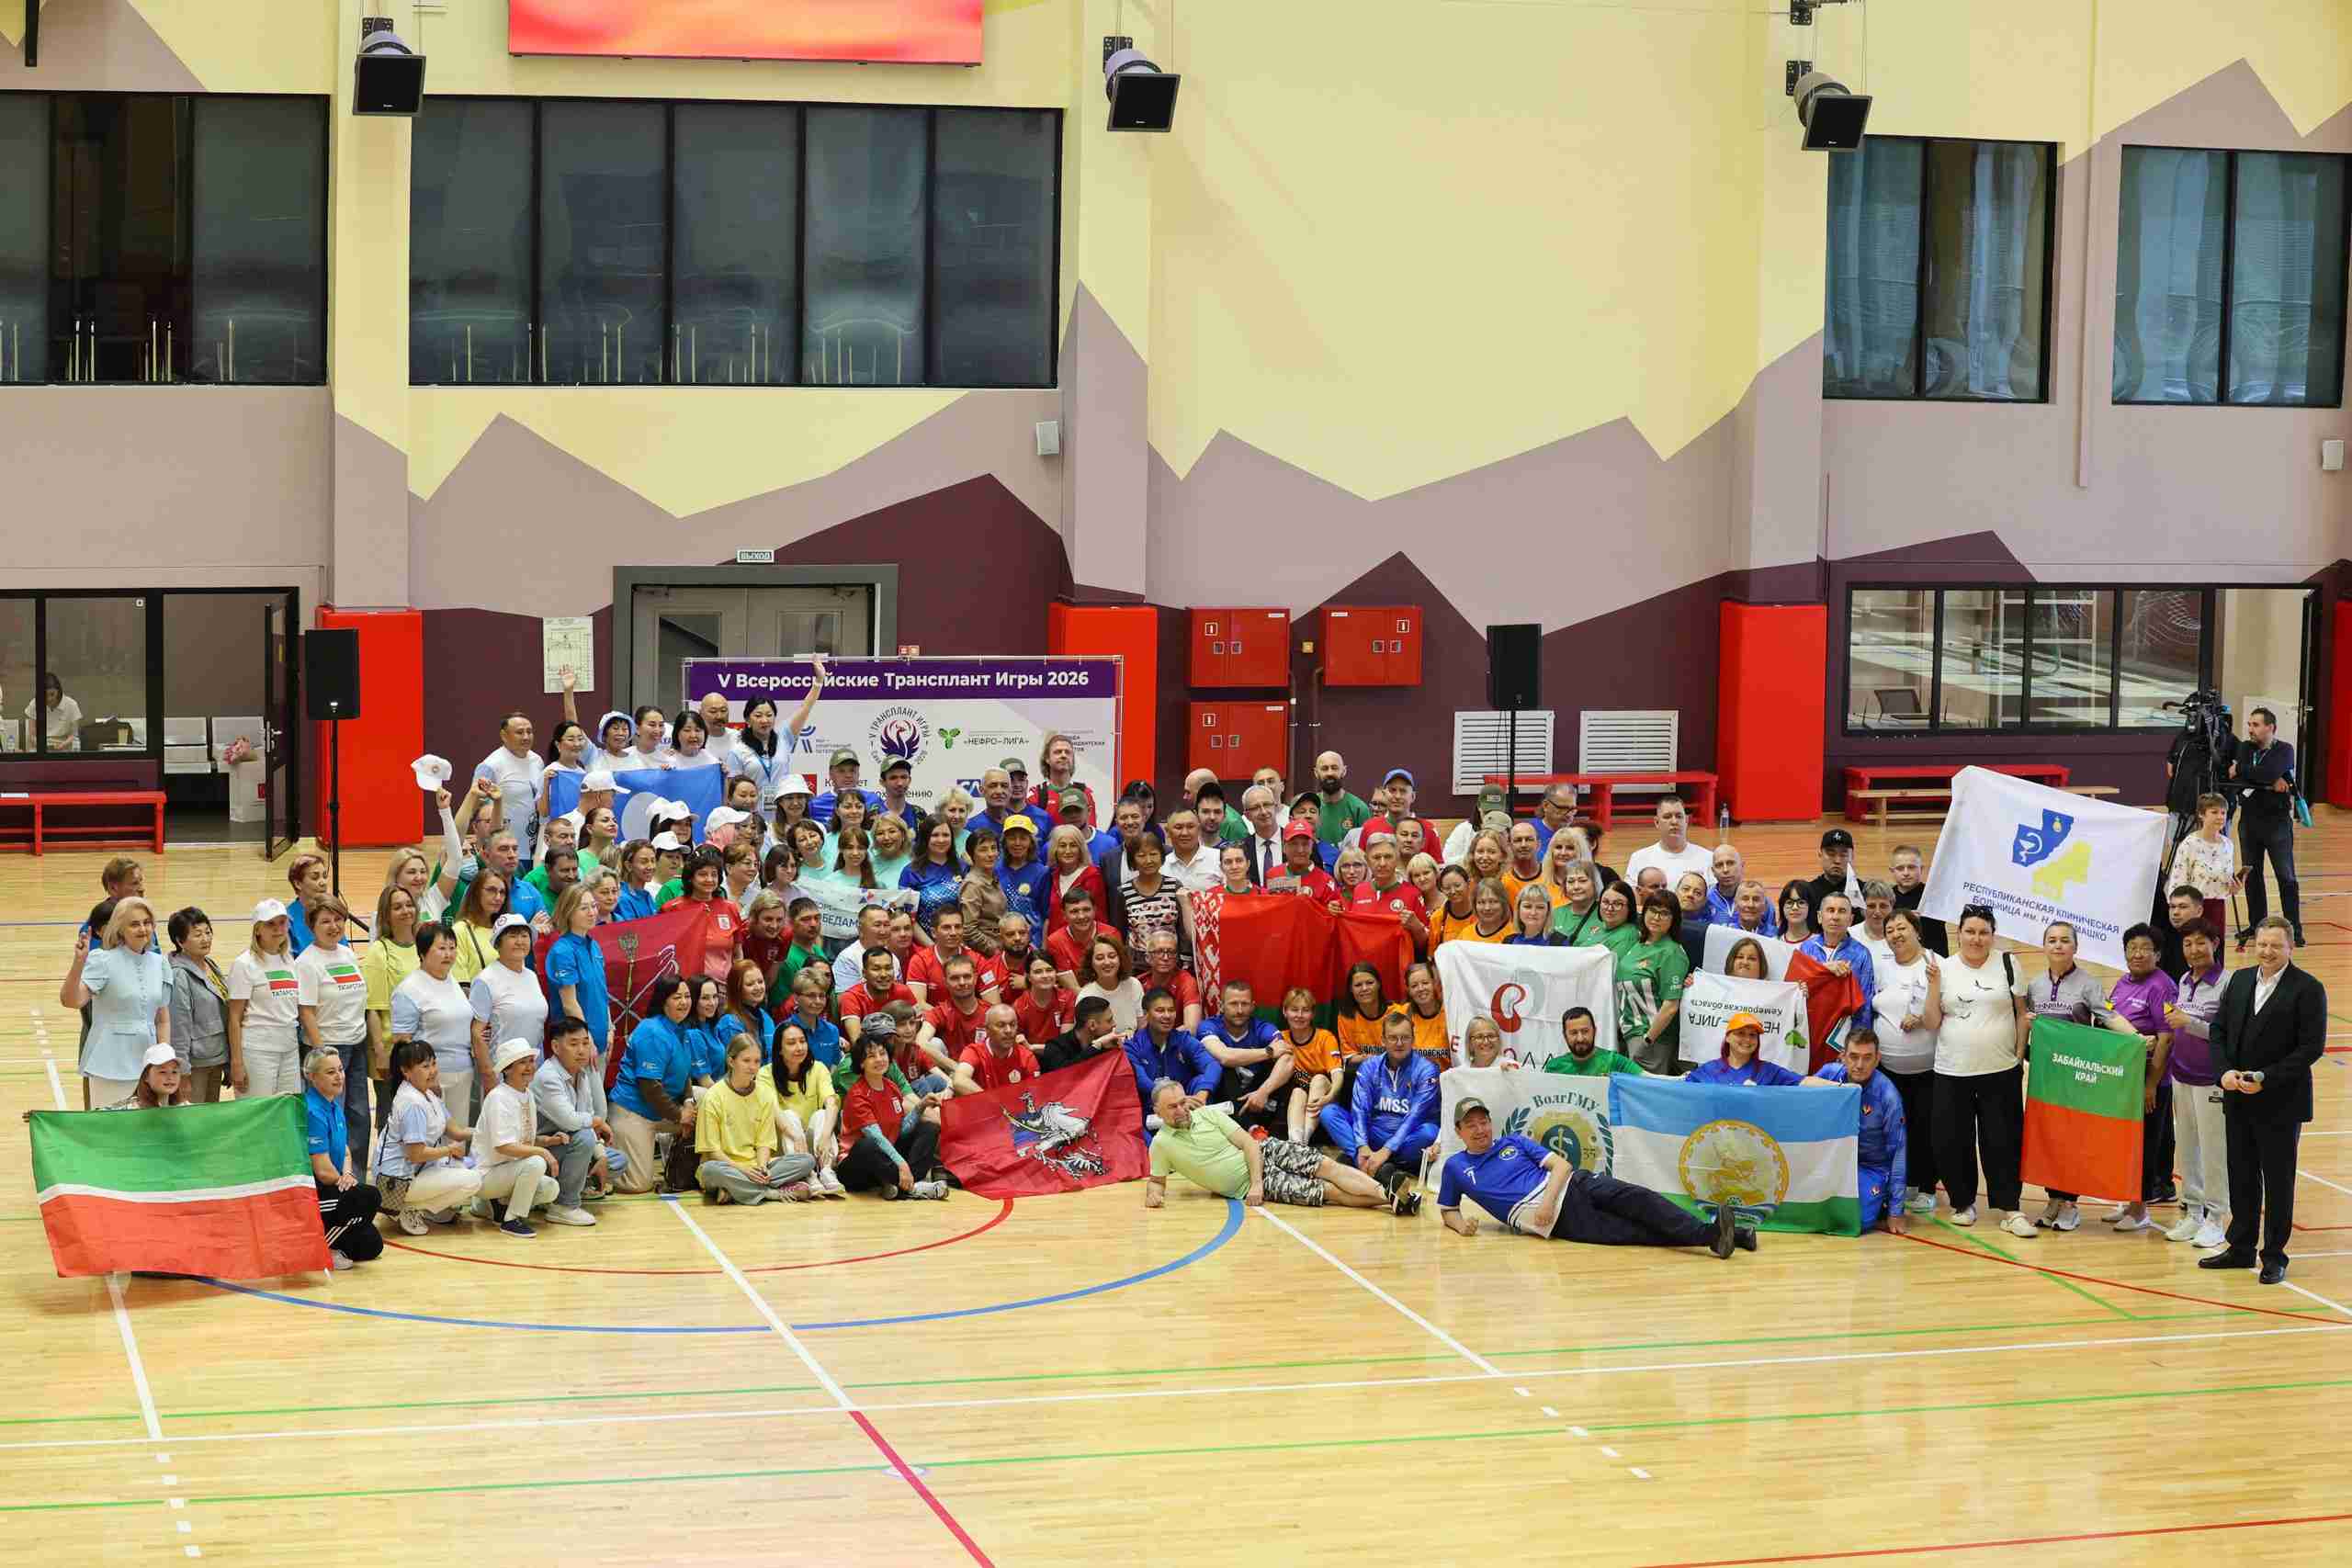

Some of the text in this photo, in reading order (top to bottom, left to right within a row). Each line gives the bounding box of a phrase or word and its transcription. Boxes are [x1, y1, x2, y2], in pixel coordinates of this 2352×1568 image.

[718, 671, 1089, 690] V Всероссйские Трансплант Игры 2026
[1962, 882, 2120, 934] РЕСПУБЛИКАНСКАЯ КЛИНИЧЕСКАЯ
[2051, 1053, 2124, 1077] ЗАБАЙКАЛЬСКИЙ
[2075, 1071, 2098, 1085] КРАЙ
[1379, 1097, 1409, 1113] MSS
[1532, 1091, 1600, 1111] ВолгГМУ
